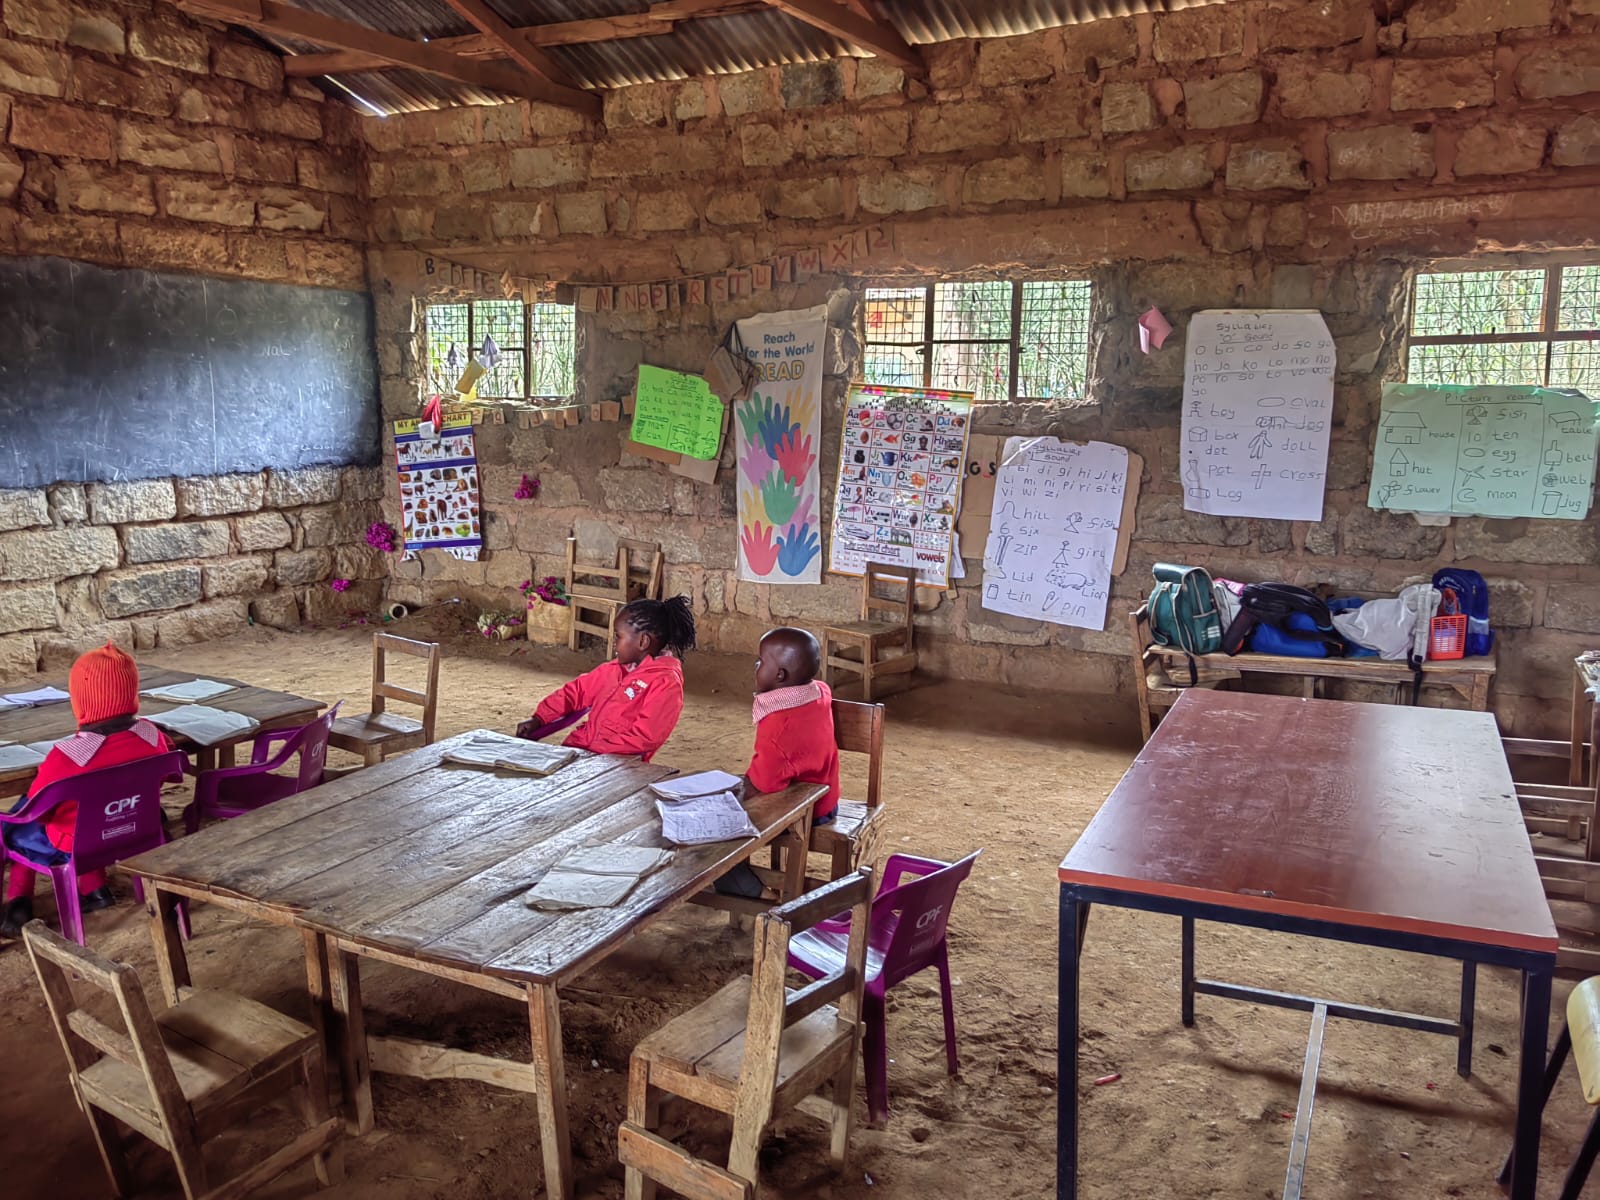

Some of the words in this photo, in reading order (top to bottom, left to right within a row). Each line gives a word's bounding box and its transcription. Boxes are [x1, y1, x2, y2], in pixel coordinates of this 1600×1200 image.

[831, 240, 849, 264] X
[763, 331, 796, 345] Reach
[763, 347, 781, 359] the
[784, 342, 815, 357] World
[754, 360, 806, 382] READ
[1467, 431, 1481, 443] 10
[1492, 430, 1520, 441] ten
[1492, 449, 1517, 464] egg
[969, 461, 981, 476] G
[1412, 462, 1433, 475] hut
[916, 552, 945, 564] vowels
[1006, 588, 1032, 602] tin
[104, 794, 141, 816] CPF
